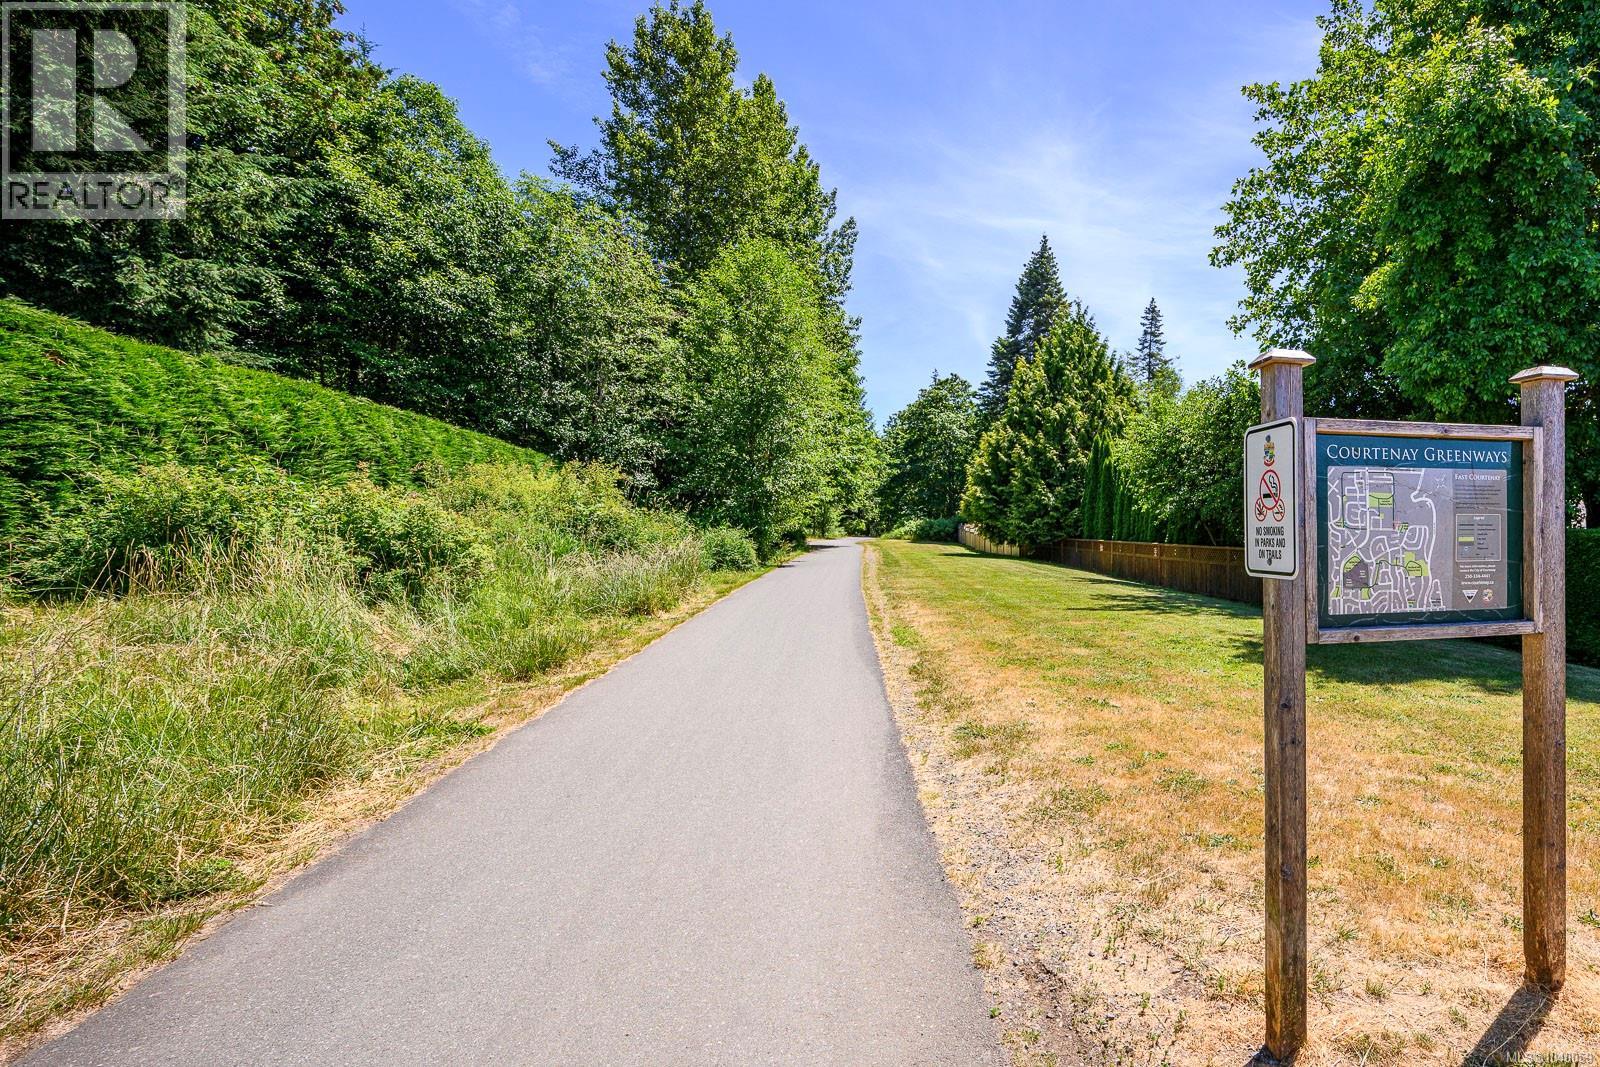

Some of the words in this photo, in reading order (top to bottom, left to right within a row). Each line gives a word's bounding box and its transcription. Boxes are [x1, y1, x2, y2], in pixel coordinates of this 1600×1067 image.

[1326, 444, 1419, 461] COURTENAY
[1424, 447, 1508, 463] GREENWAYS
[1255, 526, 1262, 536] NO
[1263, 526, 1285, 536] SMOKING
[1255, 538, 1259, 547] IN
[1260, 538, 1275, 547] PARKS
[1276, 538, 1286, 548] AND
[1258, 549, 1266, 558] ON
[1266, 549, 1282, 559] TRAILS
